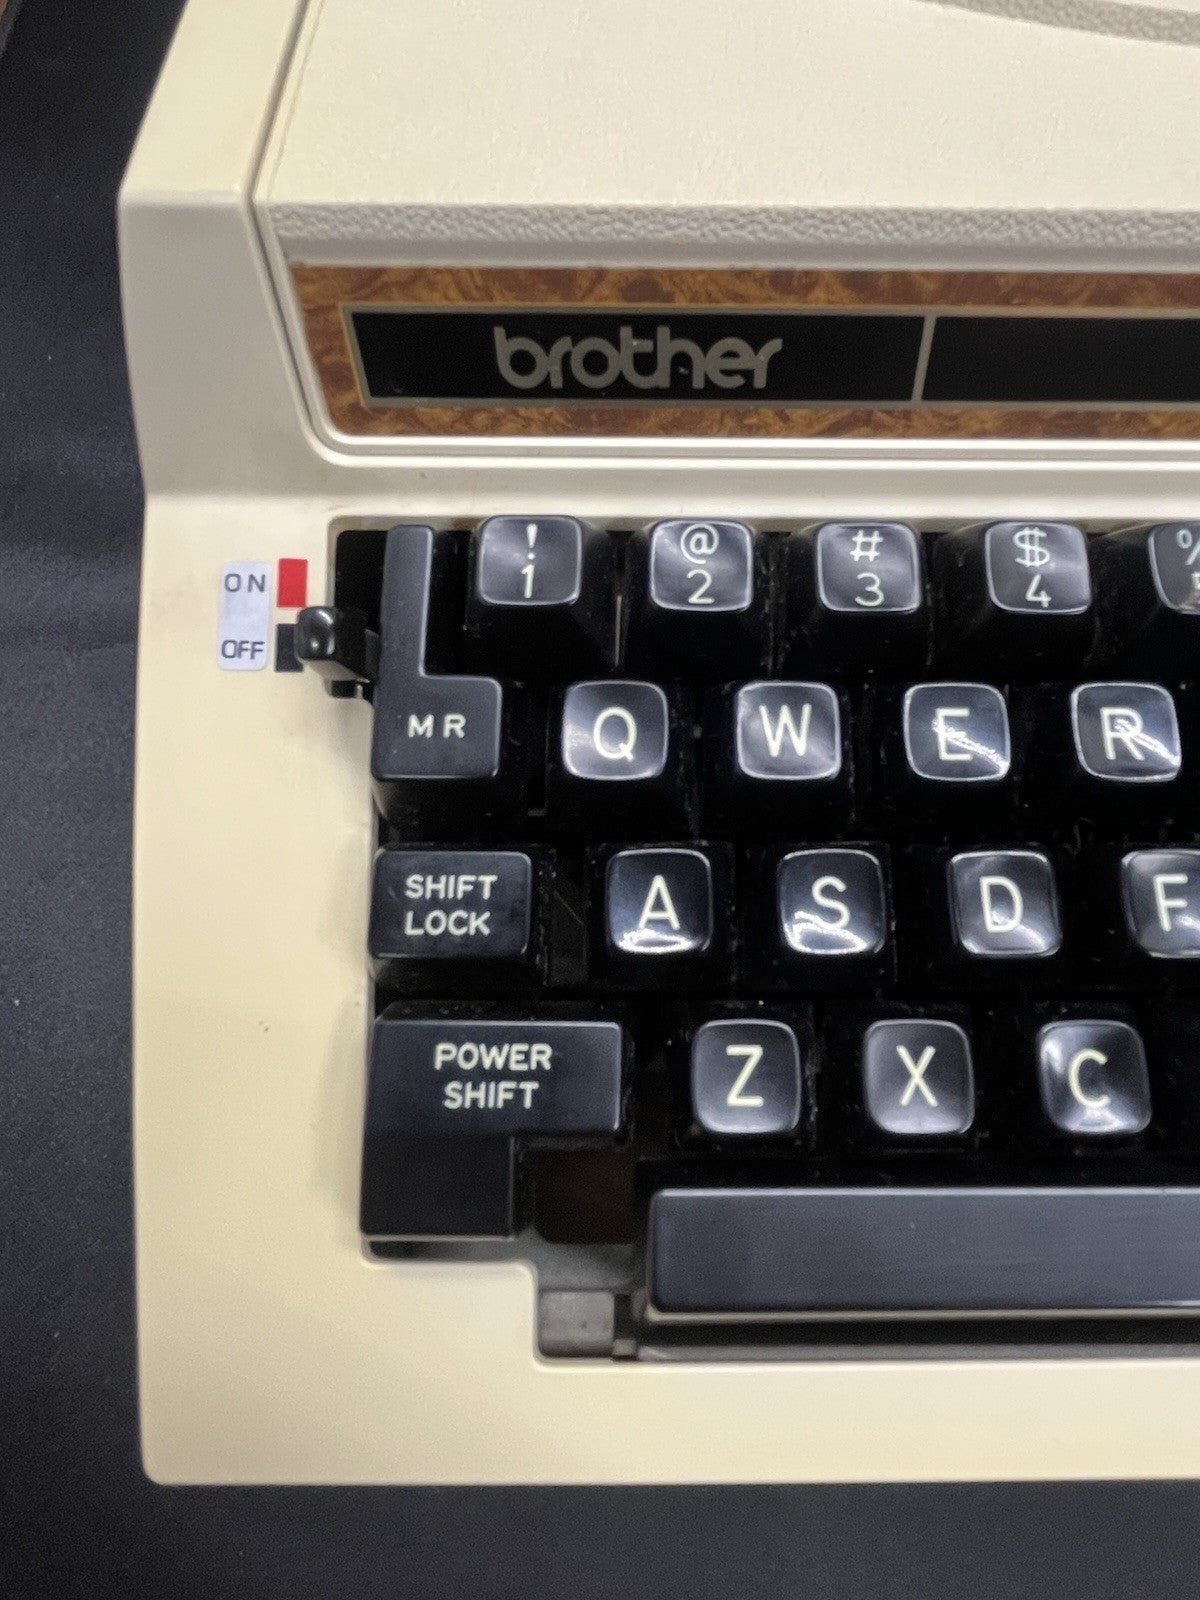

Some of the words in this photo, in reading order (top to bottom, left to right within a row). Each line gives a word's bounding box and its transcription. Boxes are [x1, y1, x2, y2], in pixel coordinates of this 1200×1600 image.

[494, 325, 783, 391] brother
[680, 523, 720, 564] @
[850, 530, 884, 562] #
[1013, 527, 1050, 568] $
[223, 573, 266, 593] ON
[522, 565, 534, 598] 1
[687, 569, 715, 604] 2
[855, 573, 884, 606] 3
[1025, 575, 1051, 608] 4
[221, 640, 264, 660] OFF
[593, 707, 638, 761] Q
[759, 704, 812, 757] W
[935, 708, 971, 761] E
[1100, 707, 1145, 760] R
[405, 874, 498, 899] SHIFT
[638, 874, 681, 930] A
[811, 876, 851, 930] S
[980, 876, 1023, 933] D
[1153, 874, 1188, 931] F
[405, 911, 491, 936] LOCK
[435, 1042, 552, 1072] POWER
[725, 1045, 764, 1107] Z
[897, 1045, 937, 1107] X
[443, 1081, 539, 1110] SHIFT
[1068, 1048, 1108, 1109] C
